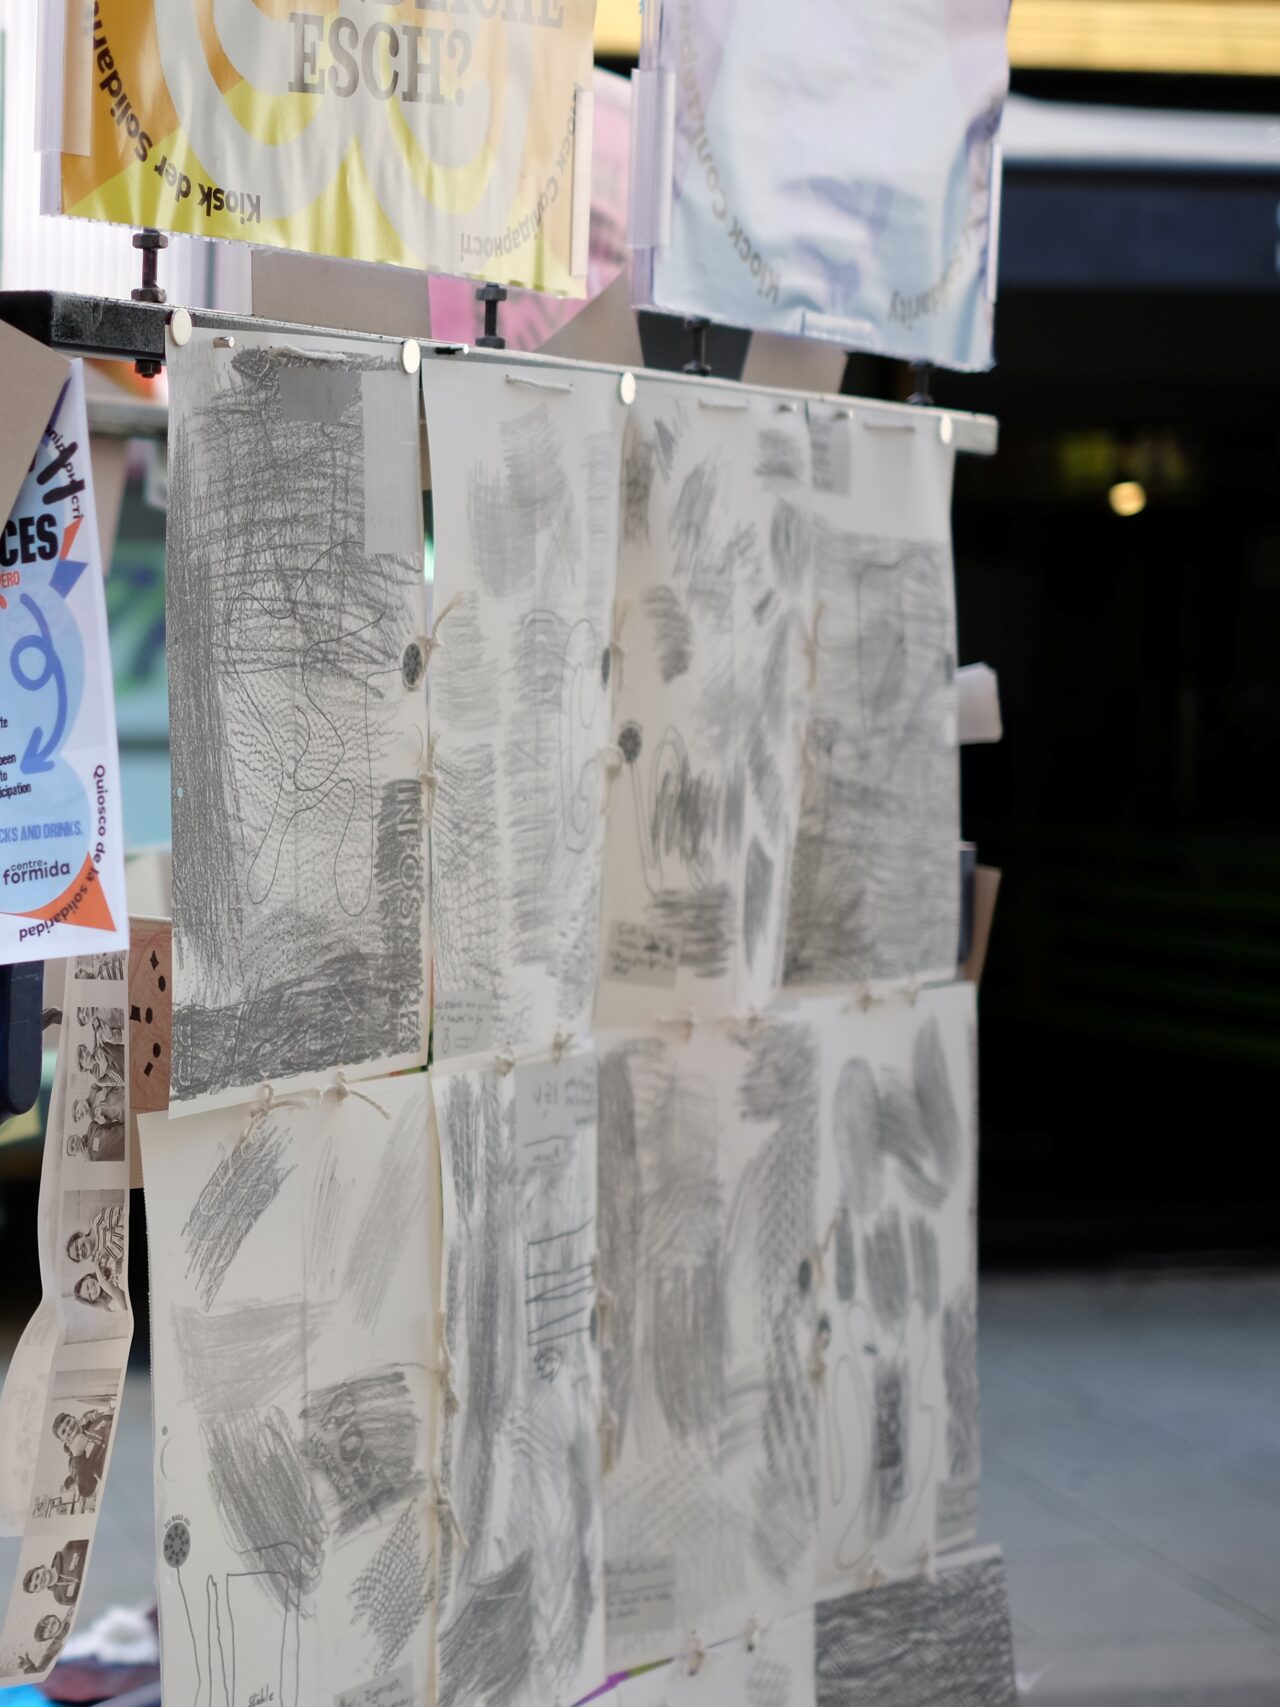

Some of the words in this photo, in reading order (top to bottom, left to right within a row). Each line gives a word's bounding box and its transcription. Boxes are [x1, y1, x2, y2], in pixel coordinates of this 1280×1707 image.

[288, 10, 473, 107] ESCH?
[154, 155, 192, 203] der
[198, 182, 261, 225] Kiosk
[0, 770, 8, 782] to
[93, 764, 108, 837] Quiosco
[20, 823, 41, 841] AND
[42, 820, 84, 839] DRINKS.
[10, 858, 43, 871] centre
[93, 841, 106, 864] de
[3, 860, 70, 886] formida
[86, 868, 100, 883] la
[19, 886, 89, 942] solidaridad
